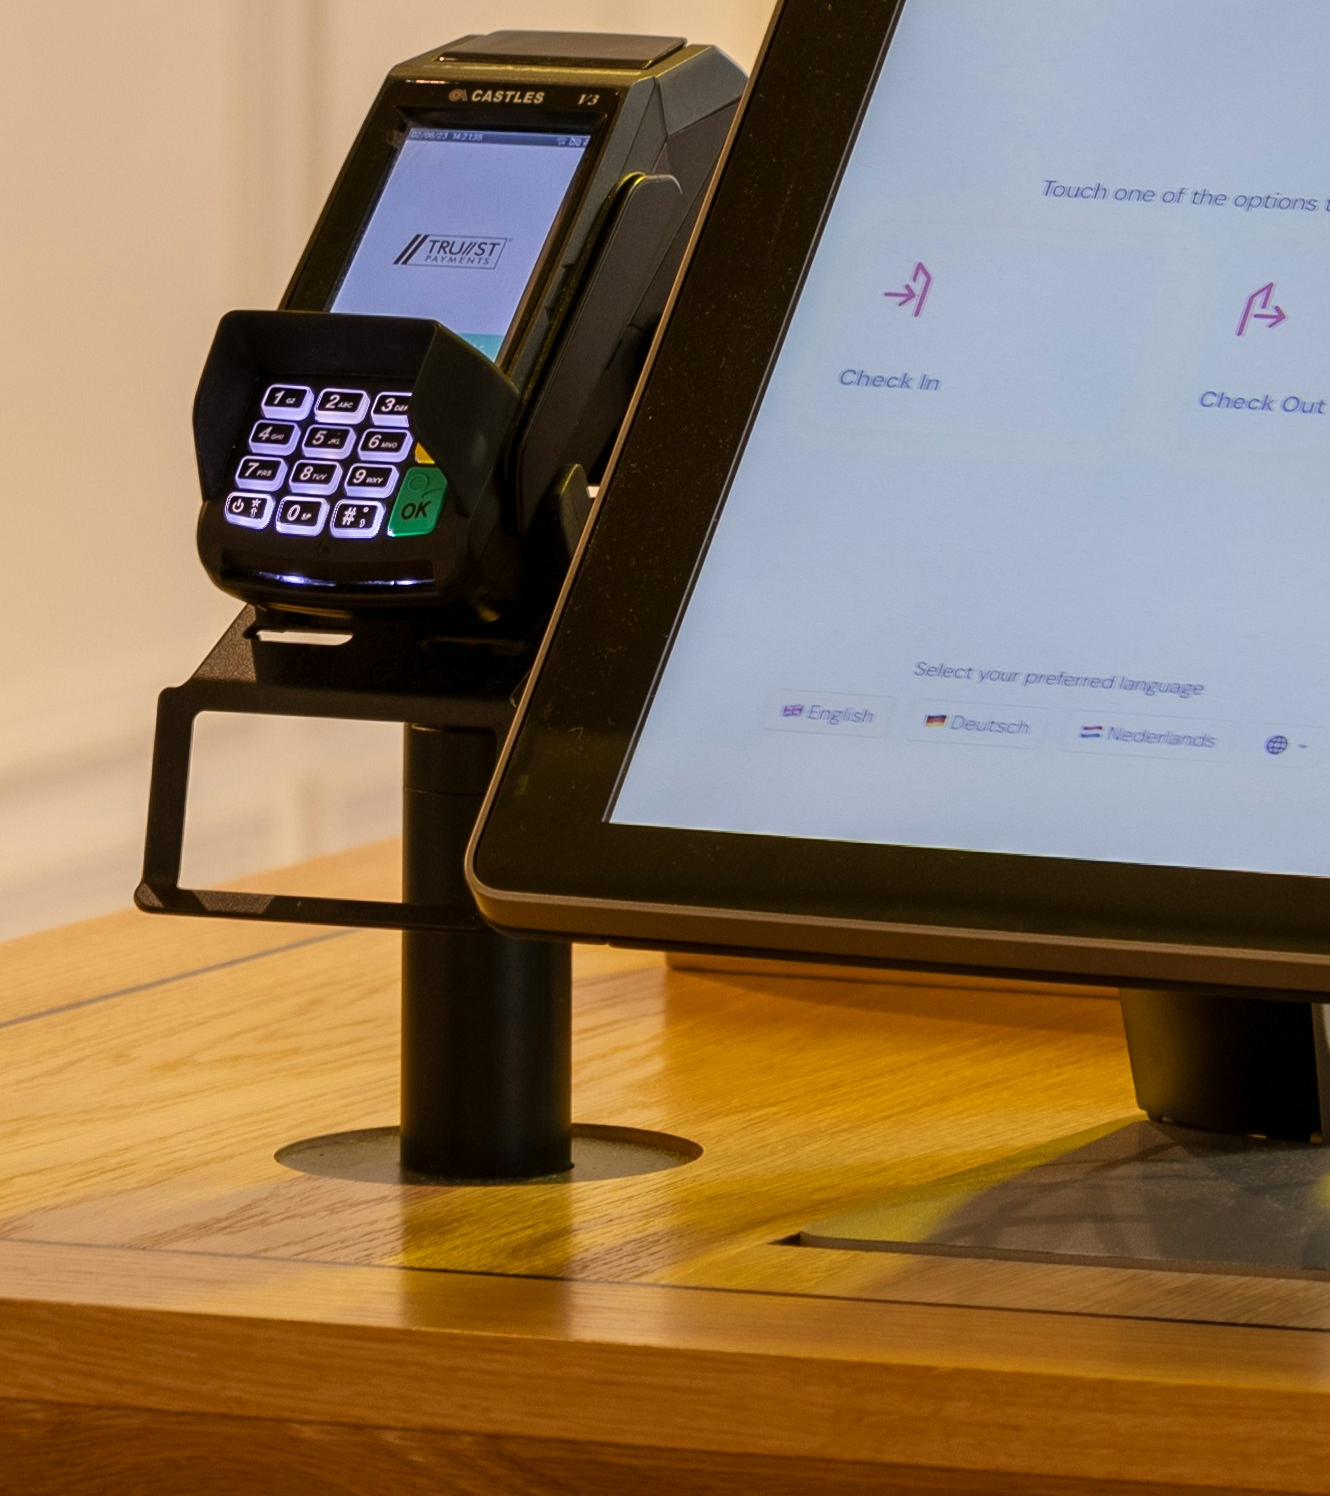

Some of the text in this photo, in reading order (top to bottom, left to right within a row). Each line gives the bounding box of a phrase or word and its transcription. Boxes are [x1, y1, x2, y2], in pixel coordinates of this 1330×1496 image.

[471, 89, 599, 106] CASTLES V3
[1043, 179, 1107, 200] Touch
[1114, 187, 1155, 203] one
[1162, 187, 1187, 204] of
[1191, 188, 1227, 207] the
[1233, 192, 1320, 213] options
[425, 255, 490, 266] PAYMENTS
[839, 368, 940, 391] Check In
[273, 390, 285, 405] 1
[325, 394, 341, 409] 2
[381, 397, 395, 412] 3
[1199, 391, 1326, 414] Check Out
[258, 426, 273, 441] 4
[312, 430, 327, 445] 5
[368, 434, 382, 449] 6
[244, 462, 259, 477] 7
[300, 466, 314, 481] 8
[352, 469, 367, 484] 9
[286, 504, 301, 521] 0
[401, 499, 432, 521] OK
[913, 661, 1206, 699] Select your preferred language
[808, 704, 1217, 749] English Deutsch Nederlands
